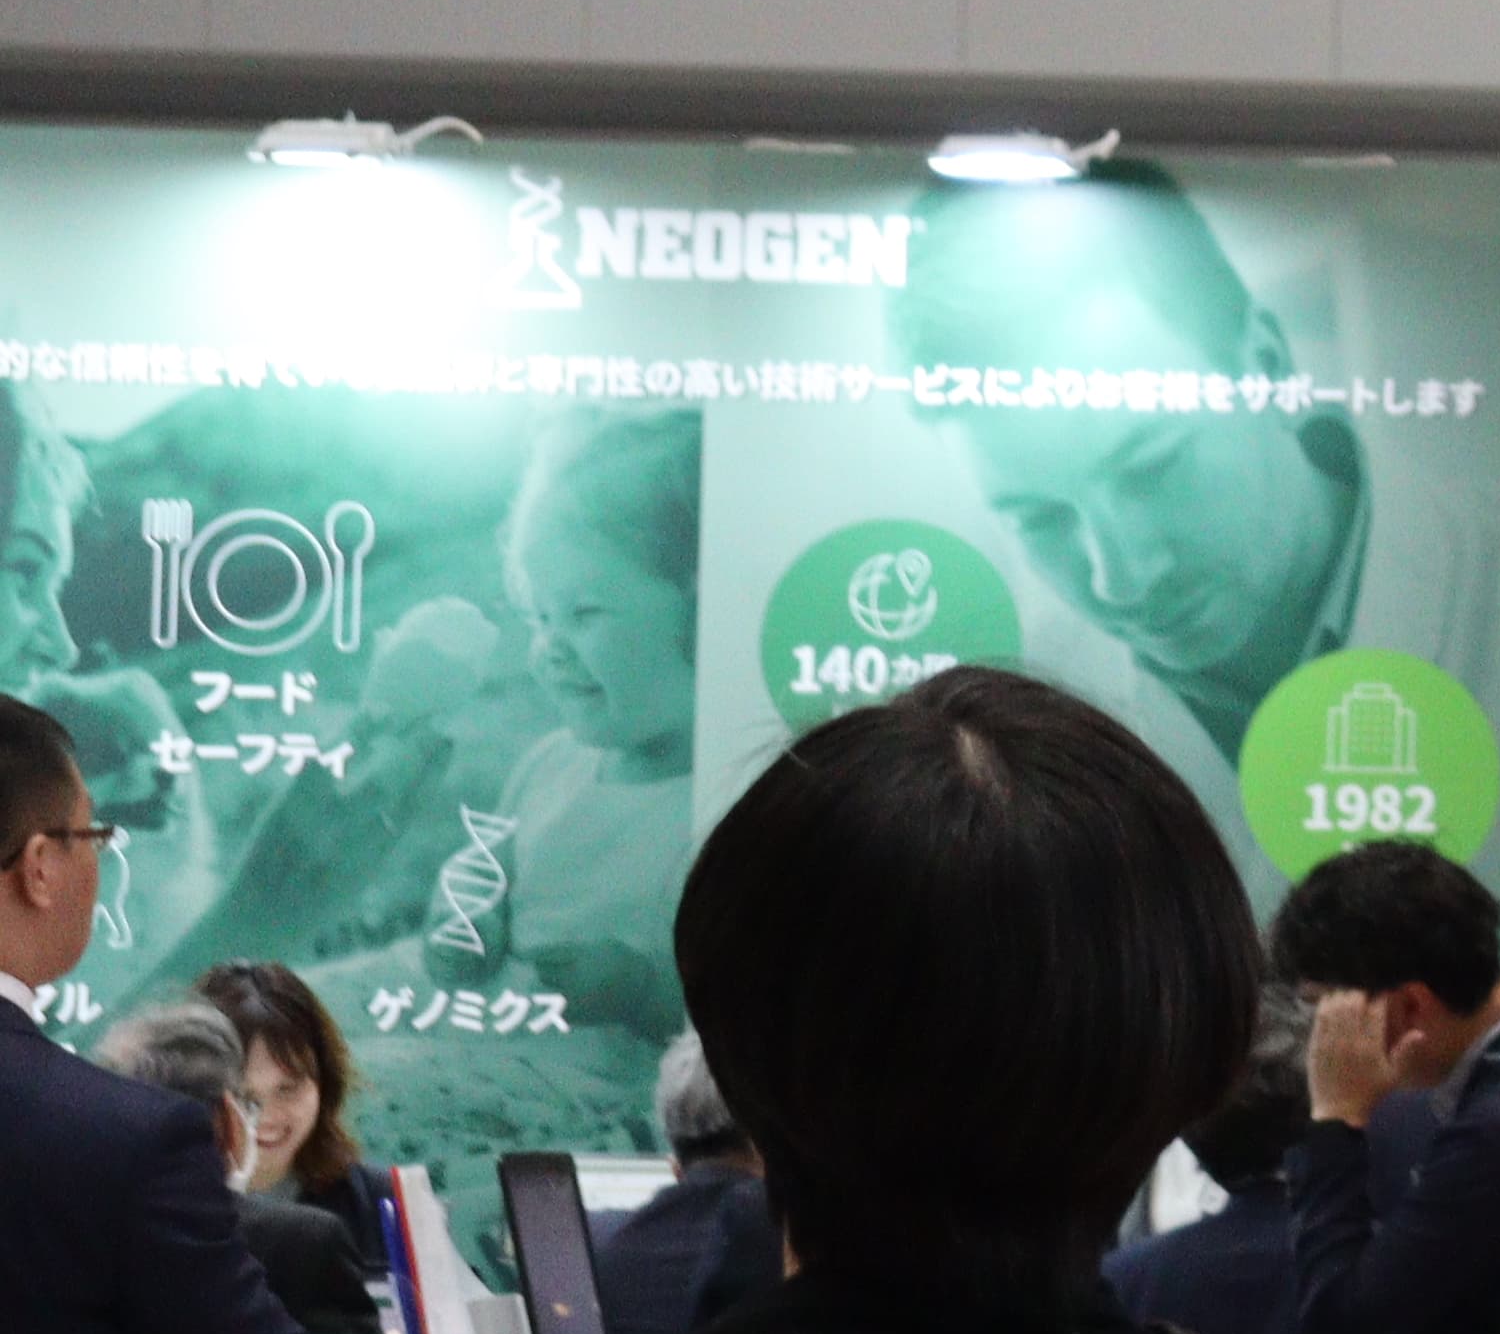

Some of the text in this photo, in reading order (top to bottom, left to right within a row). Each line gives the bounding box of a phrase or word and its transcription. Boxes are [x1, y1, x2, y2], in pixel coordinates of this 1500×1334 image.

[575, 206, 910, 288] NEOGEN
[191, 670, 318, 714] フード
[150, 731, 354, 779] セーフティ
[1304, 782, 1438, 834] 1982
[367, 986, 571, 1035] ゲノミクス
